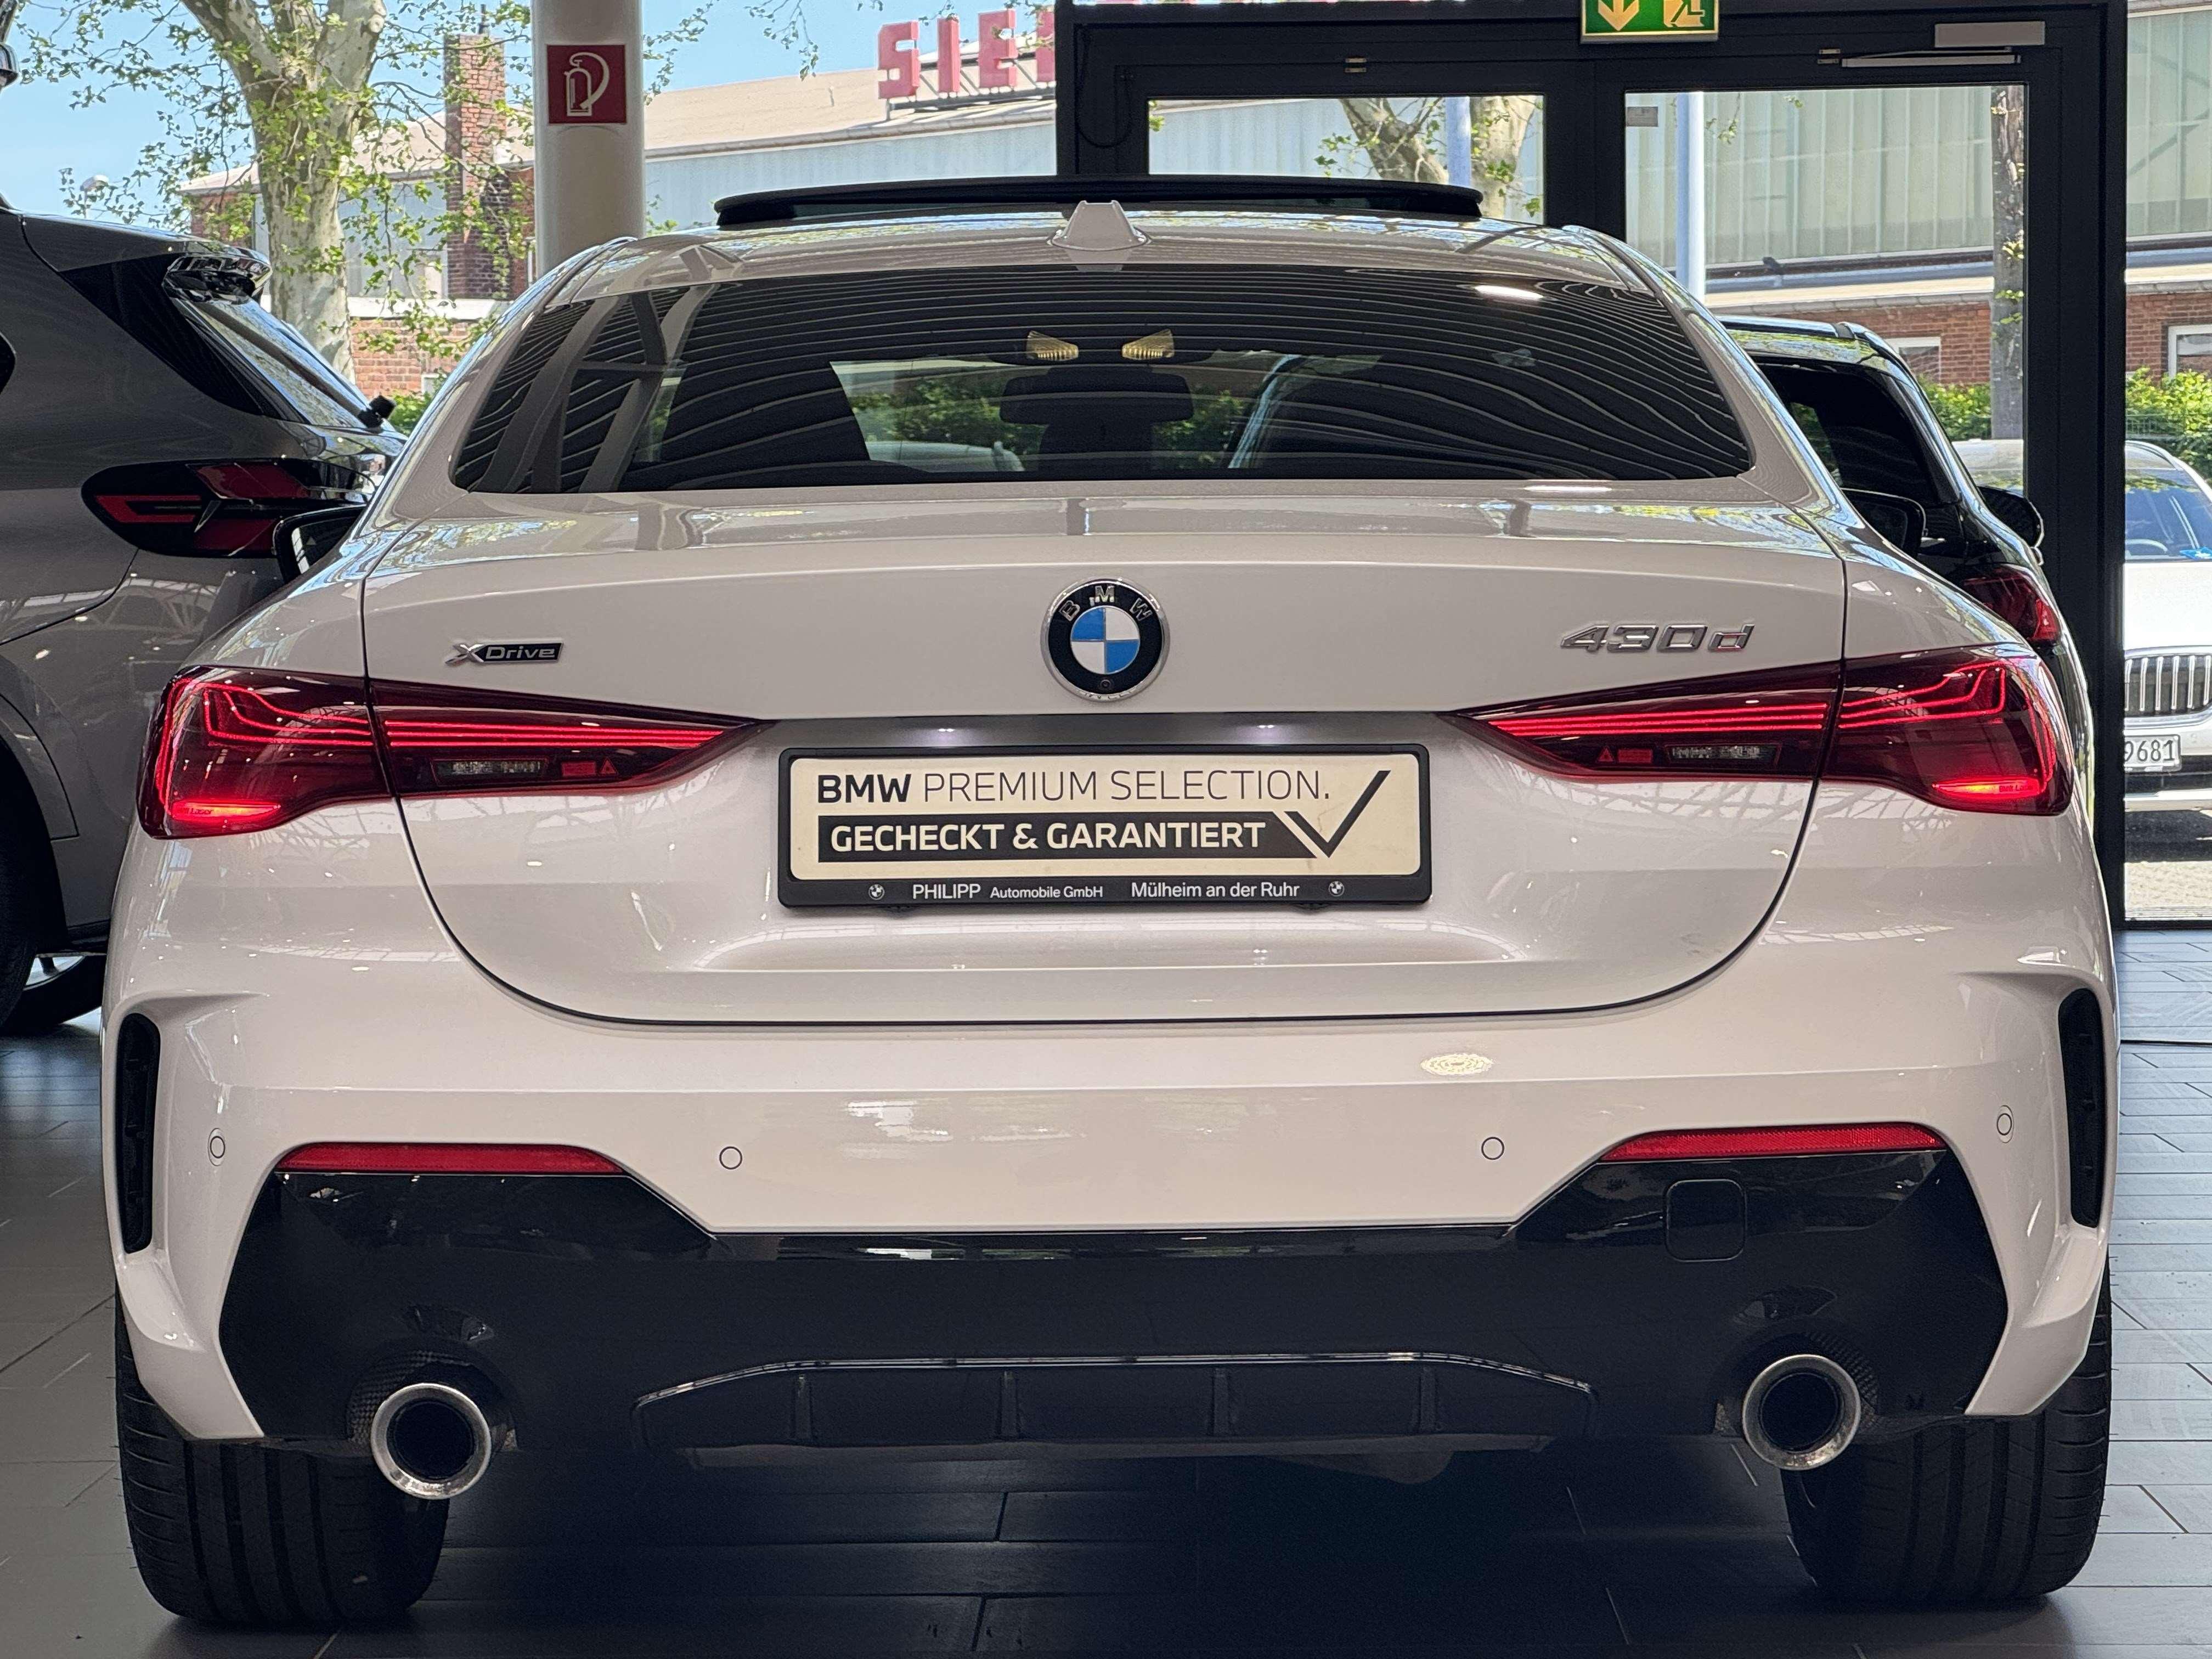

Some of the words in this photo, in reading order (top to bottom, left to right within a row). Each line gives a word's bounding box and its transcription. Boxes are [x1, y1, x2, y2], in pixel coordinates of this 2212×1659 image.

[1059, 585, 1153, 622] BMW
[1560, 624, 1755, 652] 430d
[818, 774, 911, 803] BMW
[925, 771, 1096, 802] PREMIUM
[1110, 770, 1329, 800] SELECTION.
[831, 824, 1005, 852] GECHECKT
[1012, 823, 1039, 849] &
[1047, 822, 1266, 850] GARANTIERT
[913, 884, 981, 899] PHILIPP
[990, 886, 1060, 899] Automobile
[1063, 885, 1103, 898] GmbH
[1131, 882, 1201, 898] Mülheim
[1206, 885, 1226, 897] an
[1230, 883, 1257, 897] der
[1261, 882, 1300, 897] Ruhr
